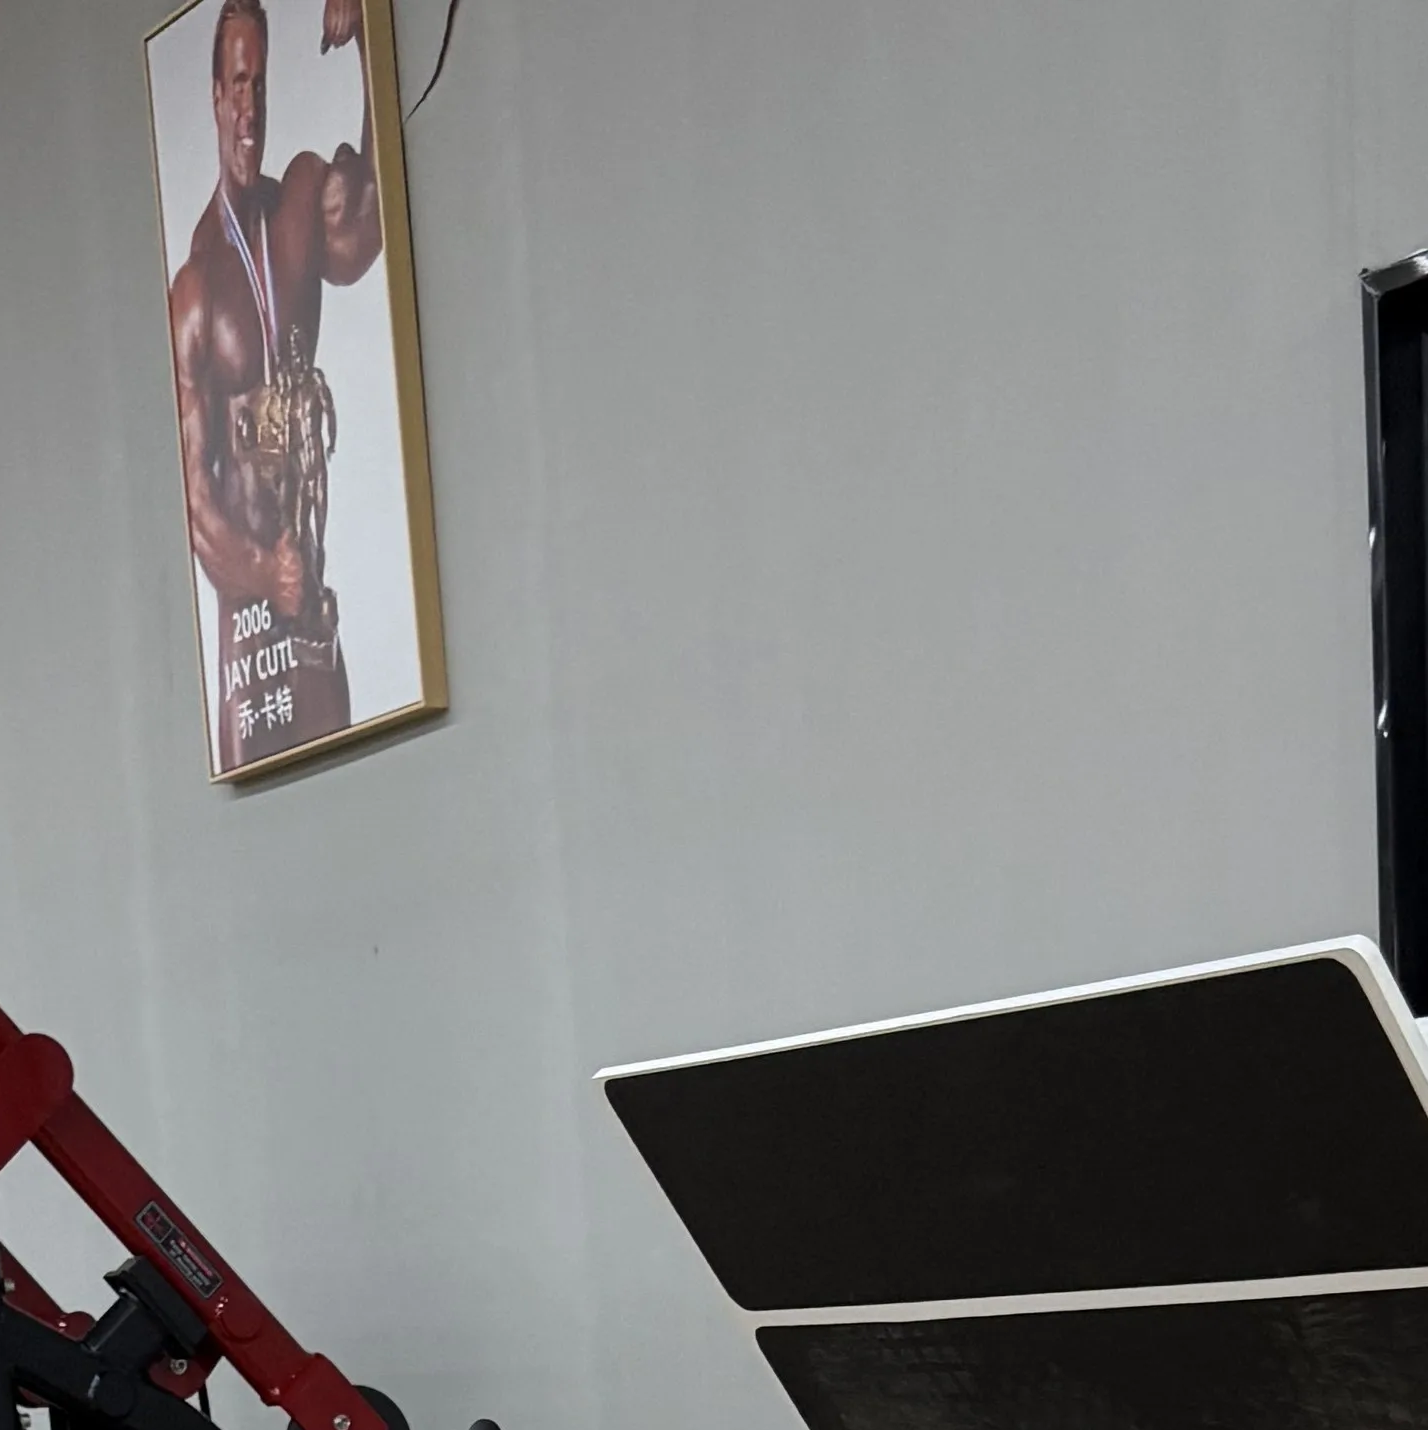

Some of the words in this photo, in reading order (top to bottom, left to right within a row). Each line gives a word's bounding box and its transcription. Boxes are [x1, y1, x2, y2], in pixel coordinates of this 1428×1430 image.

[232, 599, 272, 643] 2006
[224, 654, 252, 702] JAY
[238, 685, 293, 739] 乔·卡特
